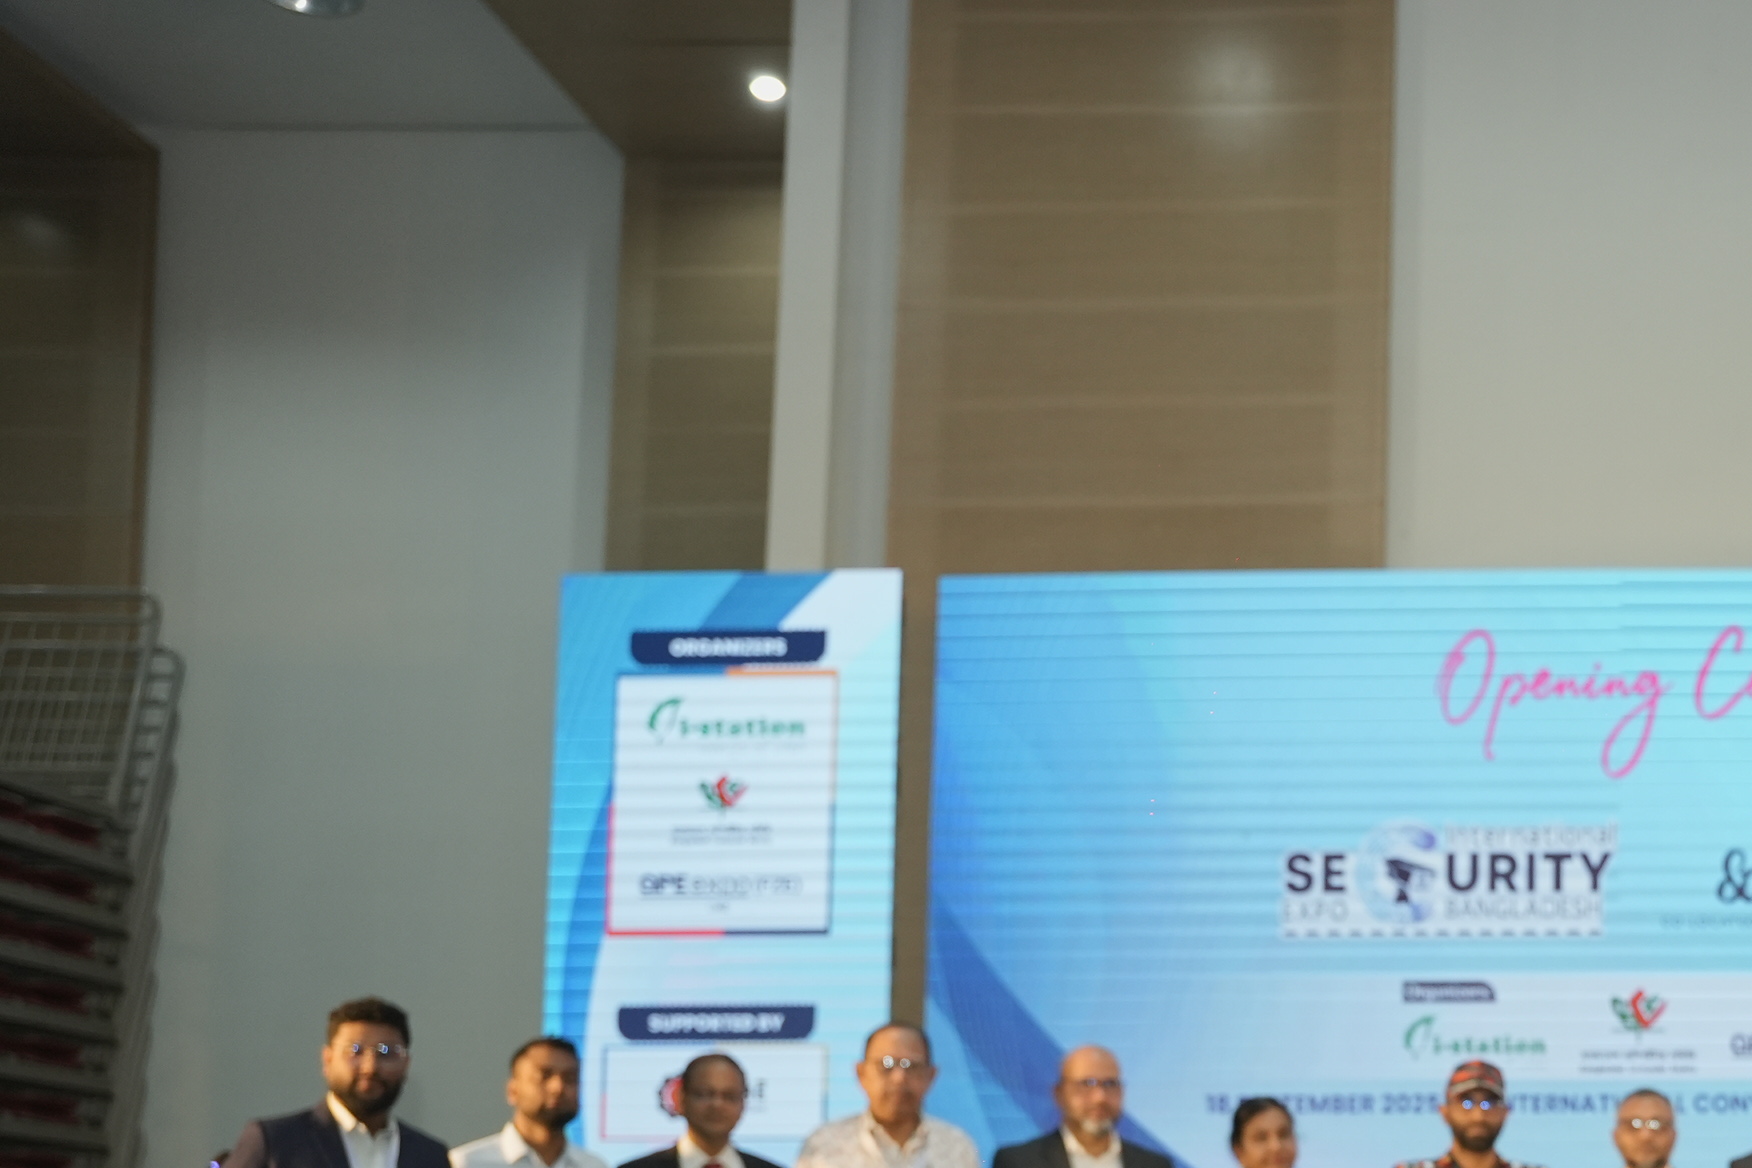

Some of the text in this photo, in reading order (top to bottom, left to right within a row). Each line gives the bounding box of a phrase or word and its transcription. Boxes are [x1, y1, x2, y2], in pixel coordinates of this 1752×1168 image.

[668, 637, 788, 658] ORGANIZERS
[1436, 628, 1672, 779] Opening
[647, 1013, 785, 1034] SUPPORTED BY
